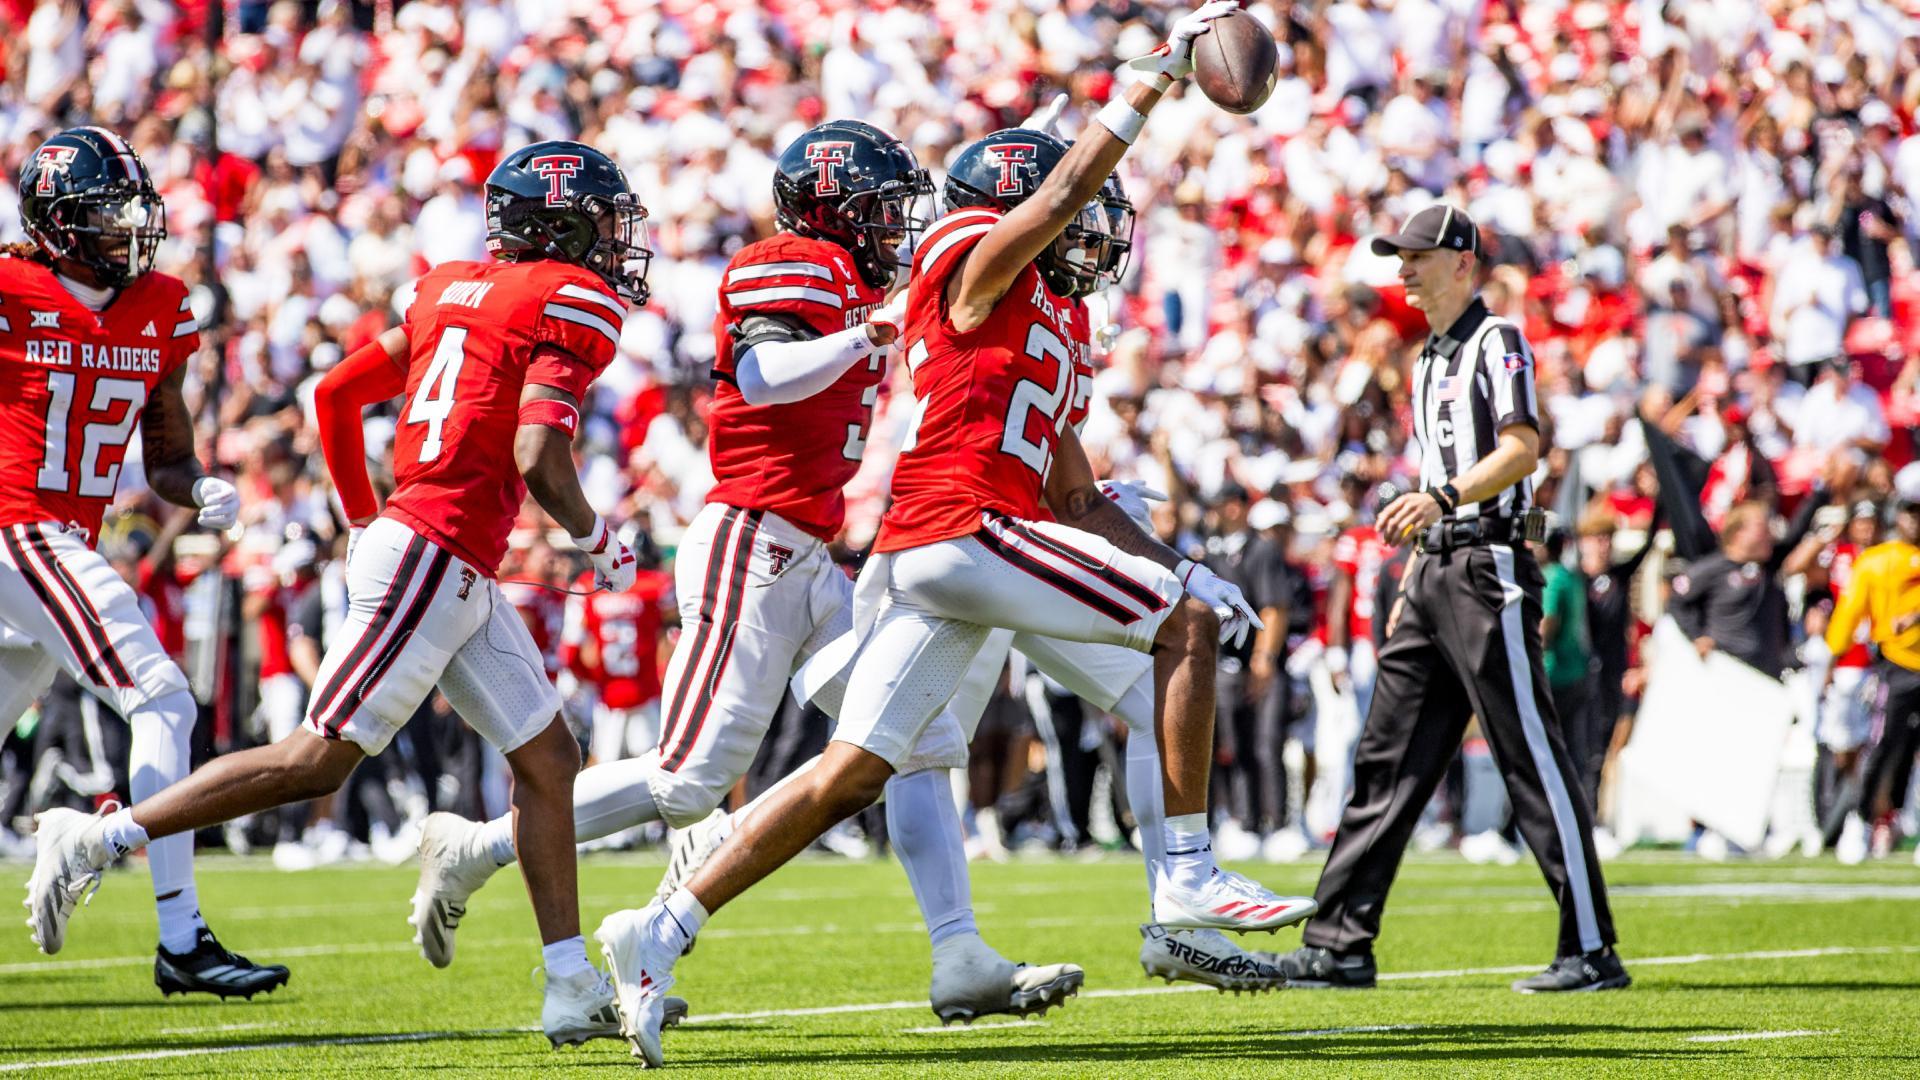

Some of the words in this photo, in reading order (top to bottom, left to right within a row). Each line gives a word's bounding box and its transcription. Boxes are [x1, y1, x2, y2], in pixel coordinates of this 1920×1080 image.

[25, 340, 72, 366] RED
[81, 343, 161, 373] RAIDERS
[407, 326, 468, 463] 4
[37, 371, 146, 498] 12
[1437, 420, 1455, 448] C
